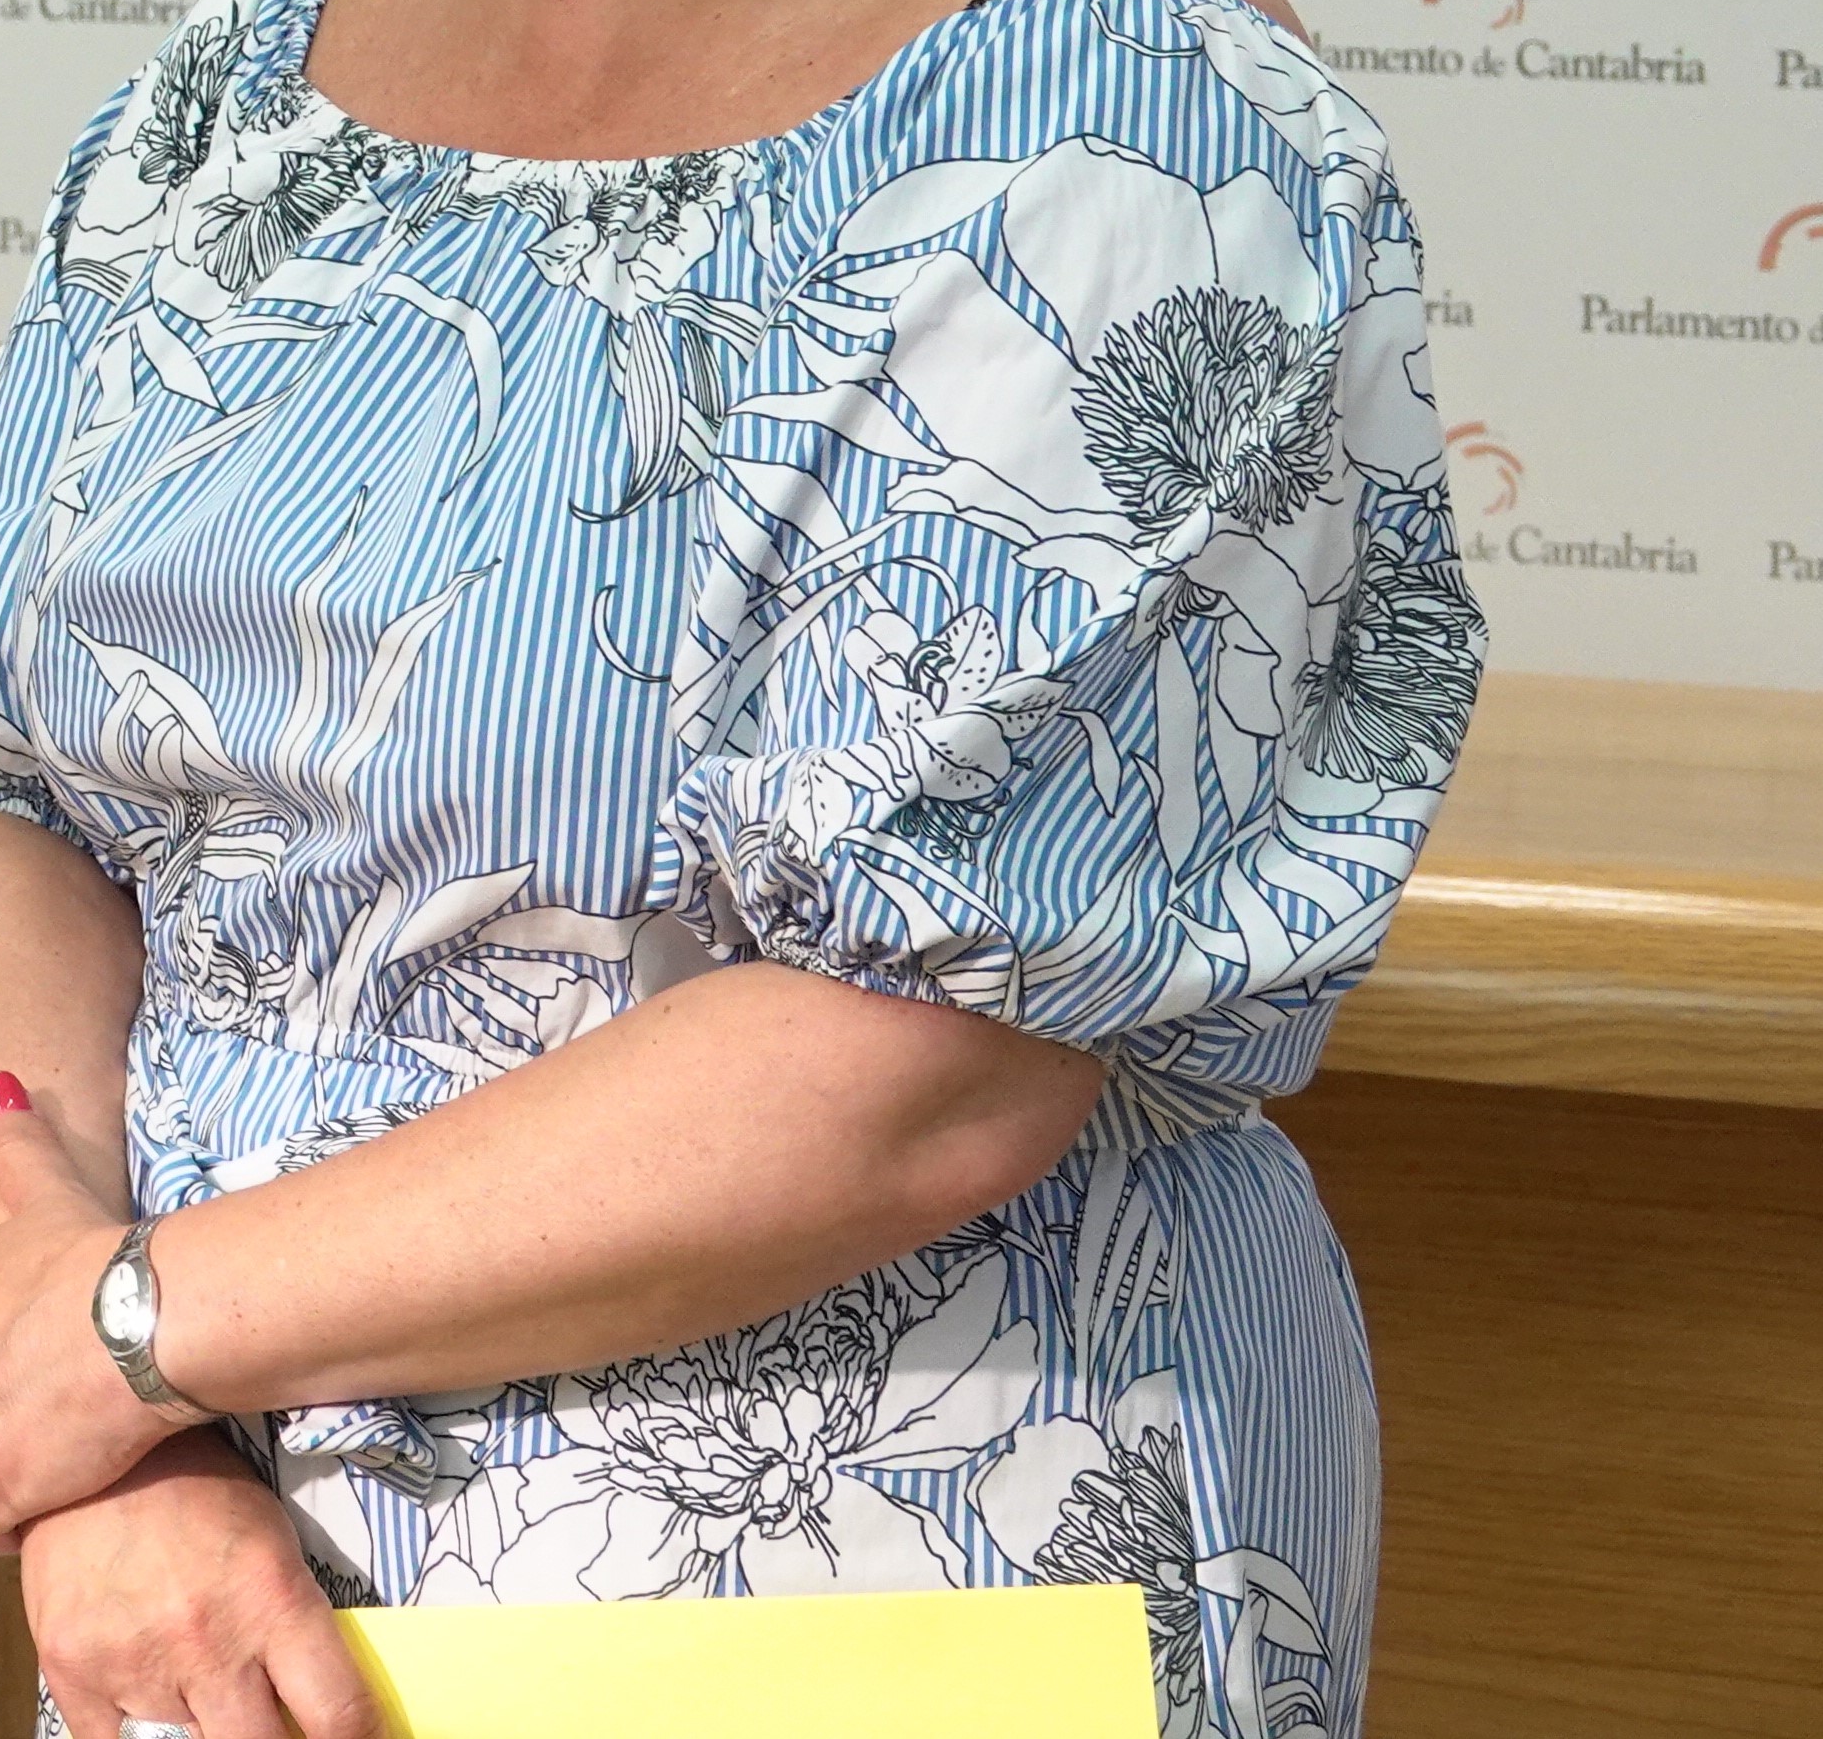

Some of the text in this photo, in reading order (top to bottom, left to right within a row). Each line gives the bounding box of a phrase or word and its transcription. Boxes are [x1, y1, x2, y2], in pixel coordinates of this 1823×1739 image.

[1471, 46, 1506, 78] de
[1515, 39, 1707, 85] Cantabria
[1581, 294, 1801, 344] Parlamento
[1506, 525, 1698, 575] Cantabria
